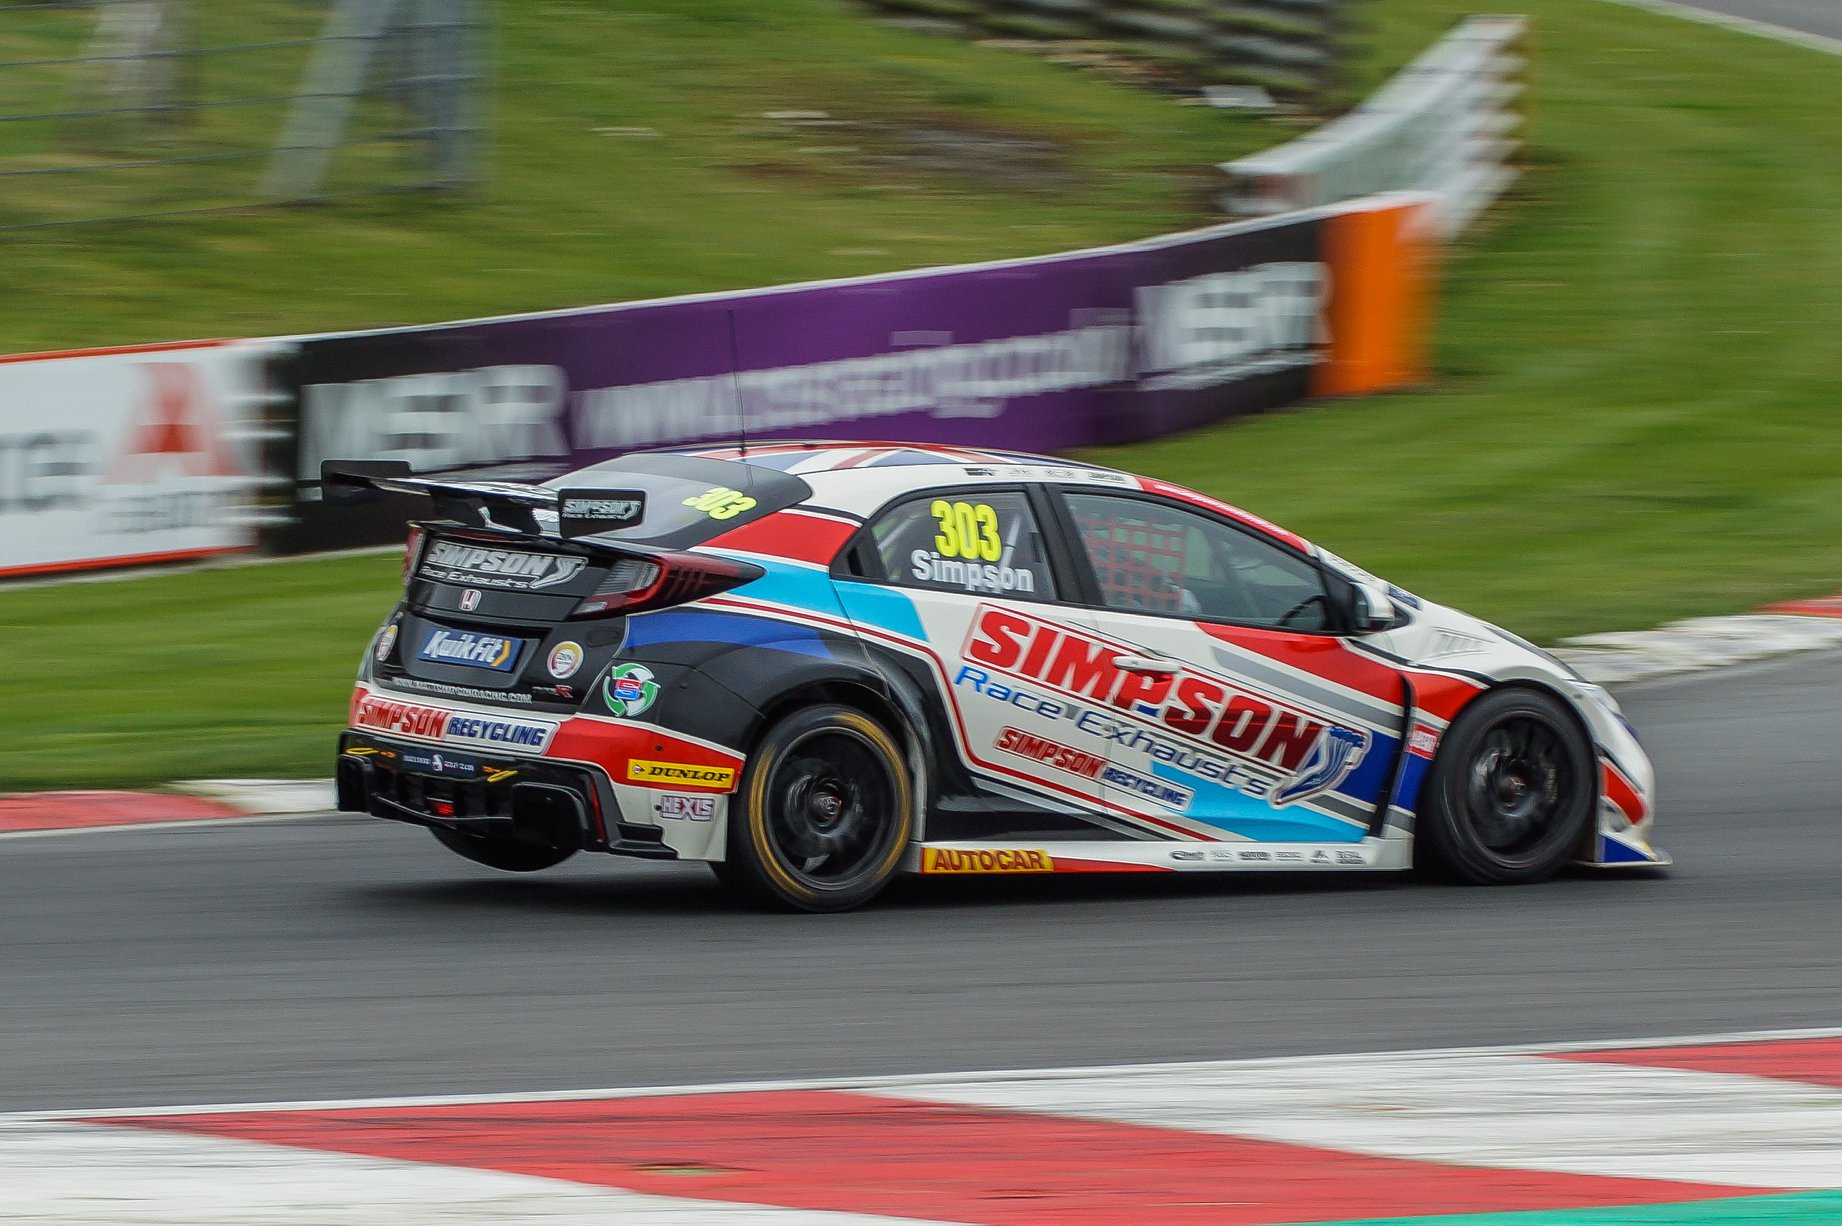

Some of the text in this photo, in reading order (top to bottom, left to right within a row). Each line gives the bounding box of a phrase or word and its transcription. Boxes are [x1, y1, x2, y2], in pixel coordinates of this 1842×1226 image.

[681, 487, 757, 520] 303
[931, 500, 1002, 562] 303
[419, 566, 529, 589] Race Exhausts
[428, 541, 555, 576] SIMPSON
[911, 549, 1035, 593] Simpson
[969, 610, 1329, 772] SIMPSON
[358, 702, 547, 746] SIMPSON RECYCLING
[954, 666, 1269, 797] Race Exhausts
[648, 766, 731, 782] DUNLOP
[998, 729, 1188, 806] SIMPSON RECYCLING
[661, 795, 715, 821] HEXIS
[934, 849, 1045, 870] AUTOCAR
